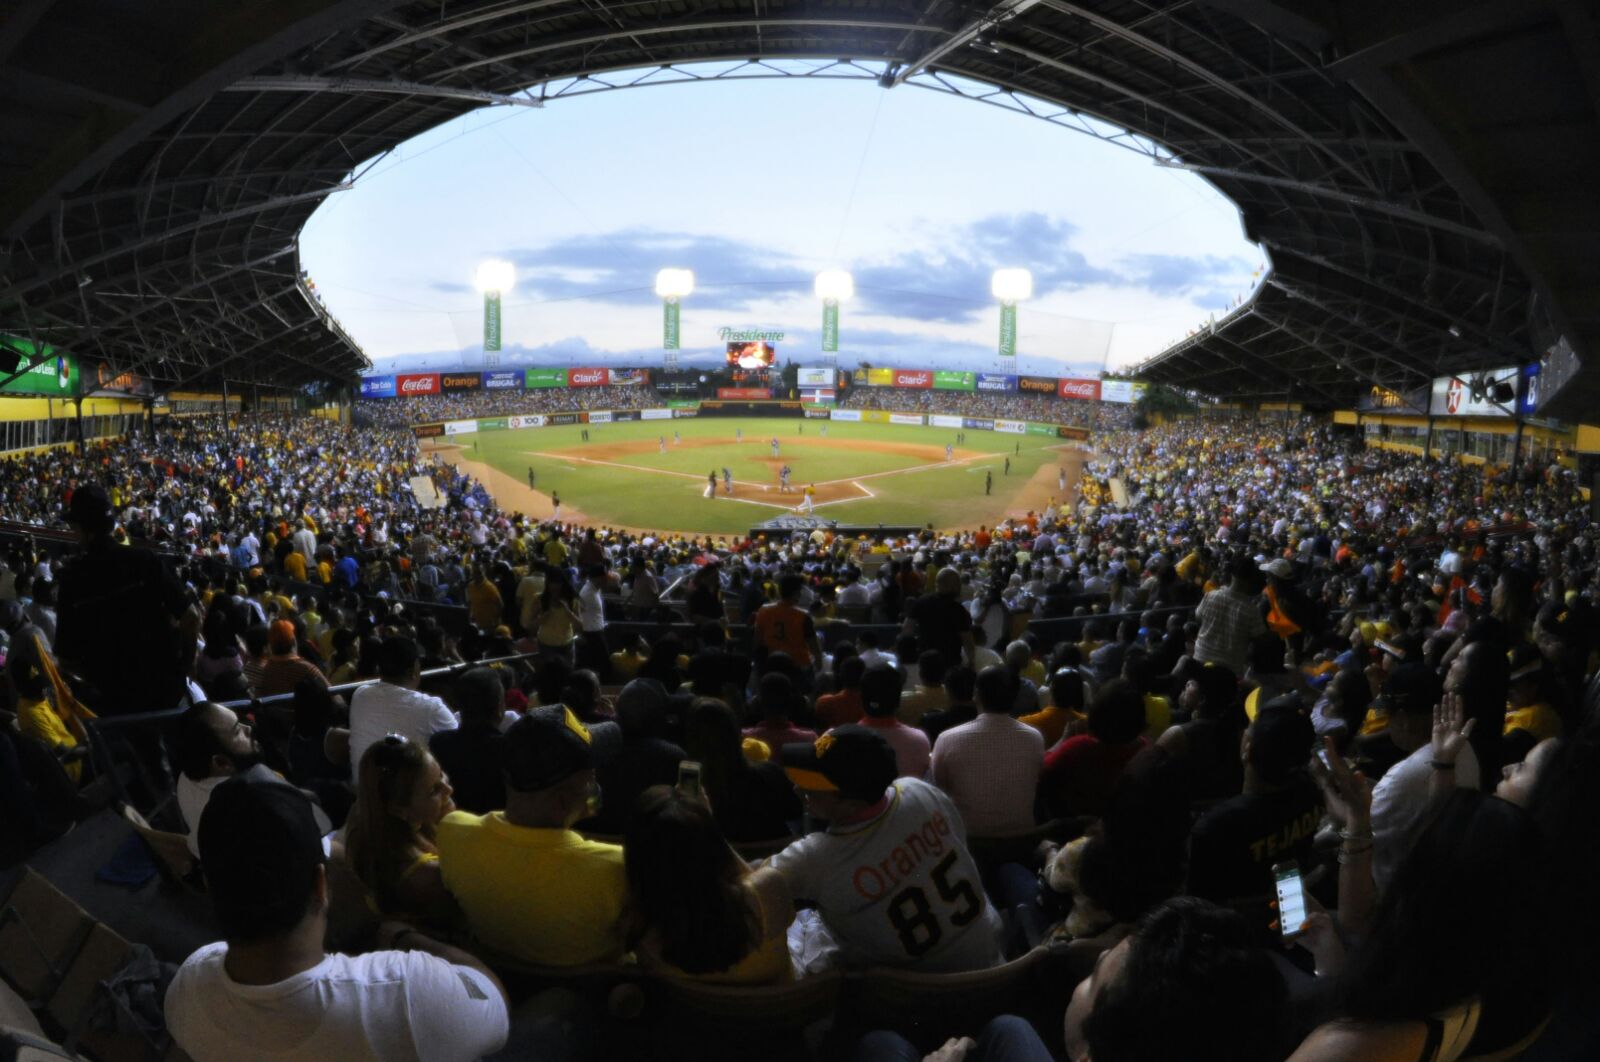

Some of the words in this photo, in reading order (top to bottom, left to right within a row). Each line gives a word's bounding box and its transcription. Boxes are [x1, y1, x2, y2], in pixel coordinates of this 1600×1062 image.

[717, 327, 784, 341] Presidente
[443, 377, 478, 387] Orange
[573, 374, 598, 382] Claro
[898, 375, 921, 384] Claro
[978, 382, 1007, 390] BRUGAL
[1021, 379, 1055, 391] Orange
[524, 416, 539, 424] 100
[774, 621, 785, 641] 3
[853, 810, 949, 899] Orange
[887, 850, 980, 956] 85
